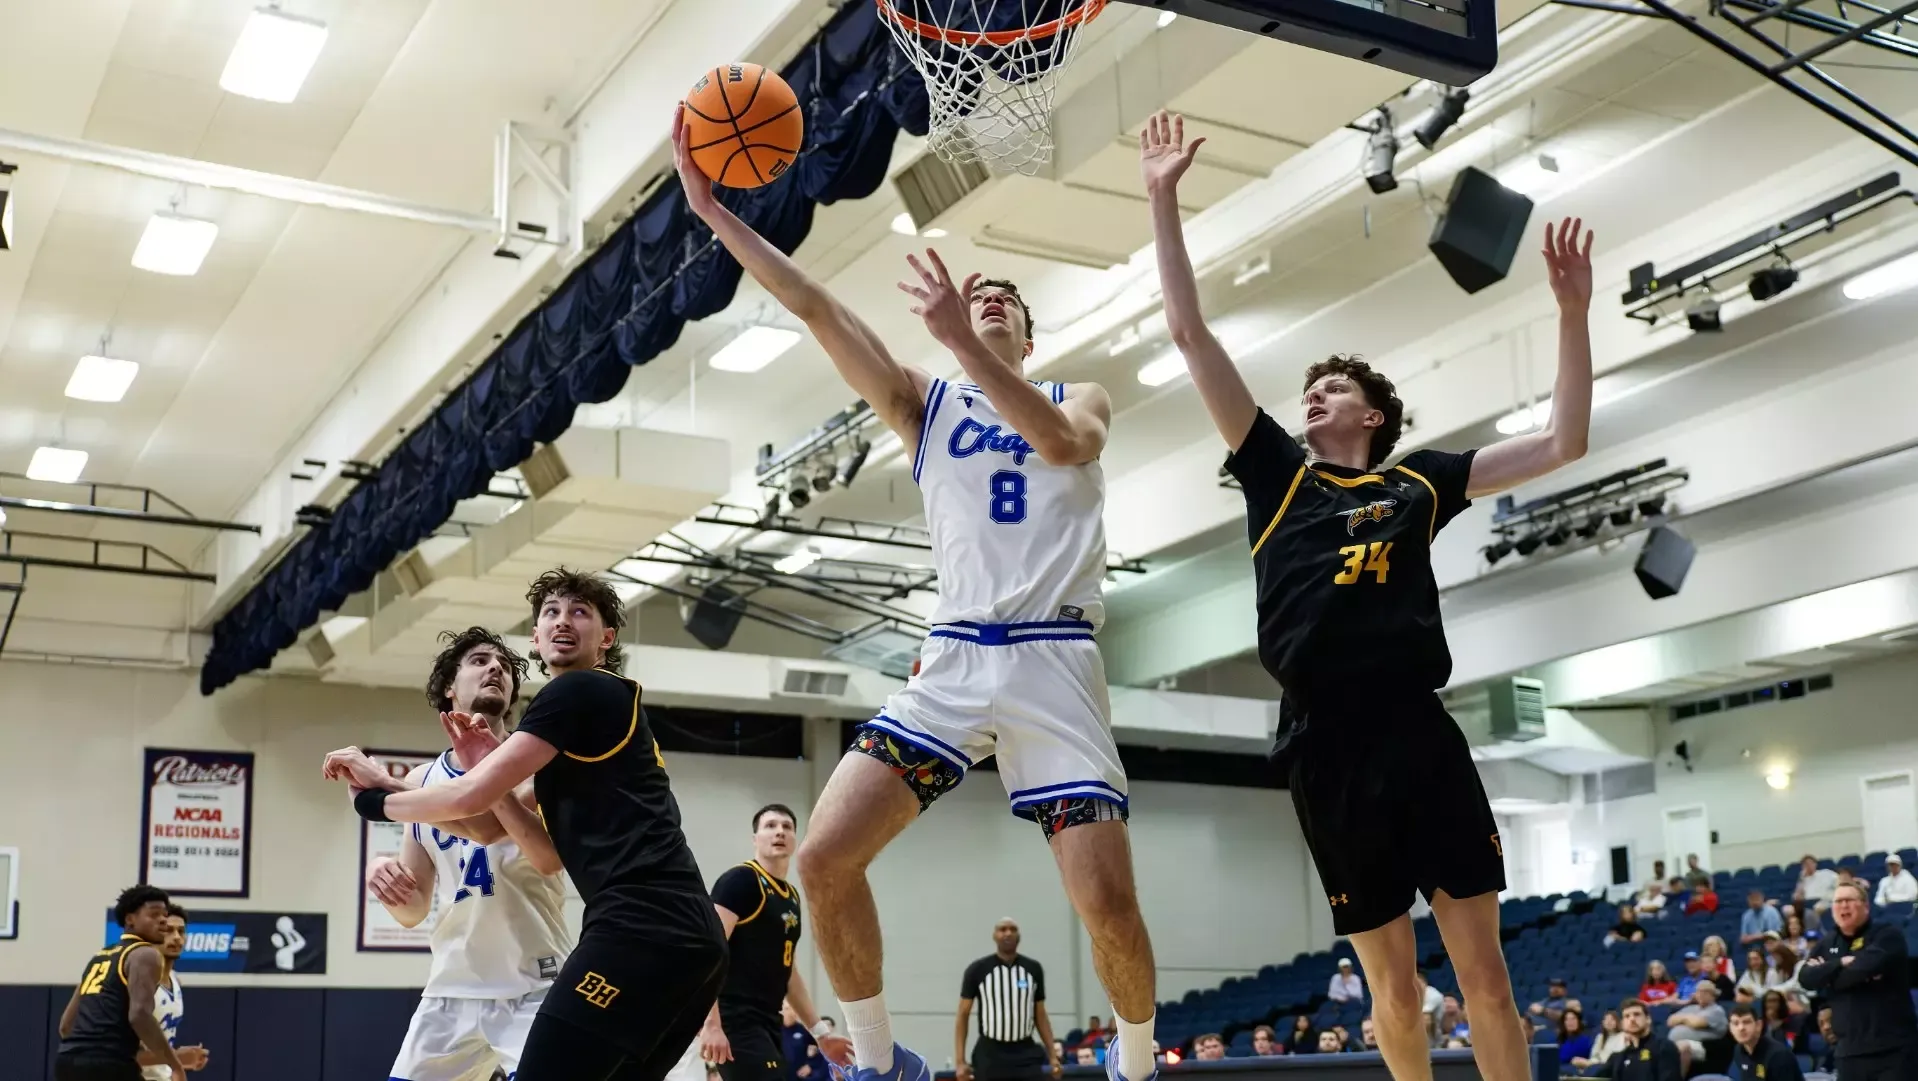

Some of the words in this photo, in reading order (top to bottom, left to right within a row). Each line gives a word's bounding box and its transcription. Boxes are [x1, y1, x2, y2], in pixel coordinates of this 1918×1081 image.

[989, 469, 1027, 524] 8
[1334, 542, 1393, 584] 34
[153, 756, 246, 788] Patriots
[154, 824, 241, 840] REGIONALS
[174, 807, 222, 822] NCAA
[79, 960, 112, 995] 12
[575, 971, 620, 1008] BH
